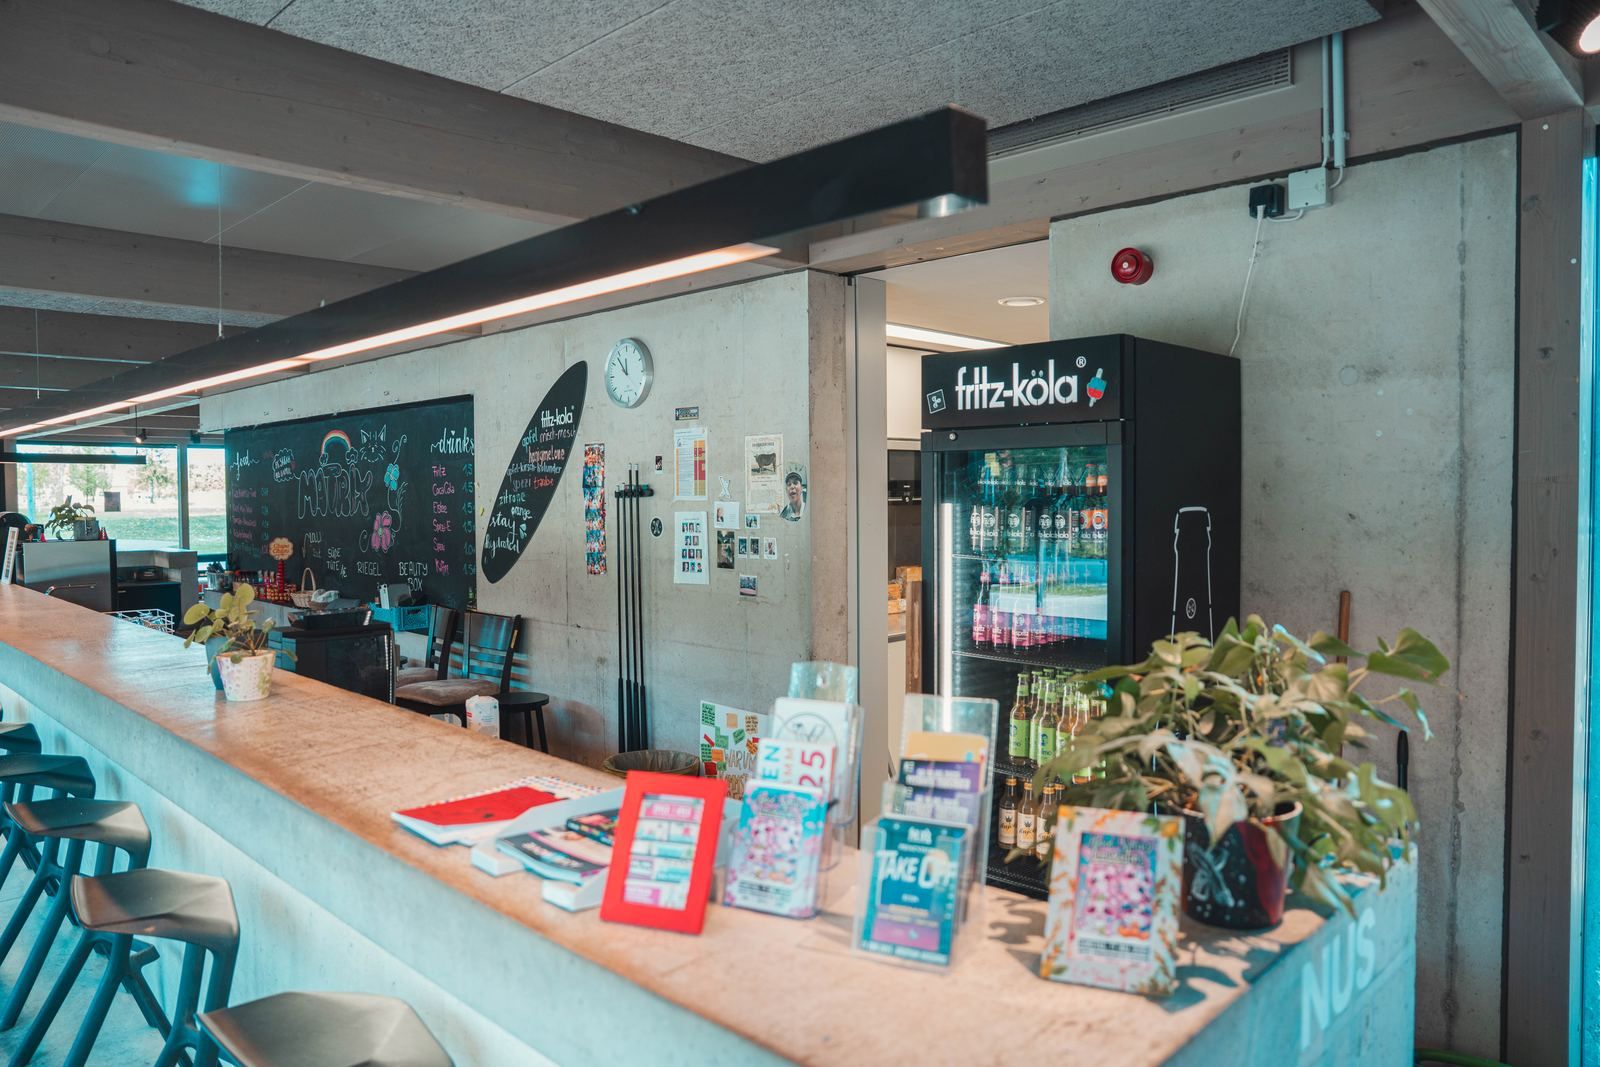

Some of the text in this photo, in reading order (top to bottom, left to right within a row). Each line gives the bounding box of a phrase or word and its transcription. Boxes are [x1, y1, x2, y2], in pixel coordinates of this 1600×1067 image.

[436, 427, 474, 456] drinks
[522, 427, 538, 453] apfel
[528, 445, 565, 463] honigmelone
[499, 489, 526, 505] zitrone
[490, 511, 517, 543] stay
[485, 533, 520, 558] hydrated
[356, 561, 382, 577] RIEGEL
[398, 561, 429, 576] BEAUTY
[407, 577, 423, 591] BOX
[876, 849, 920, 883] TAKE
